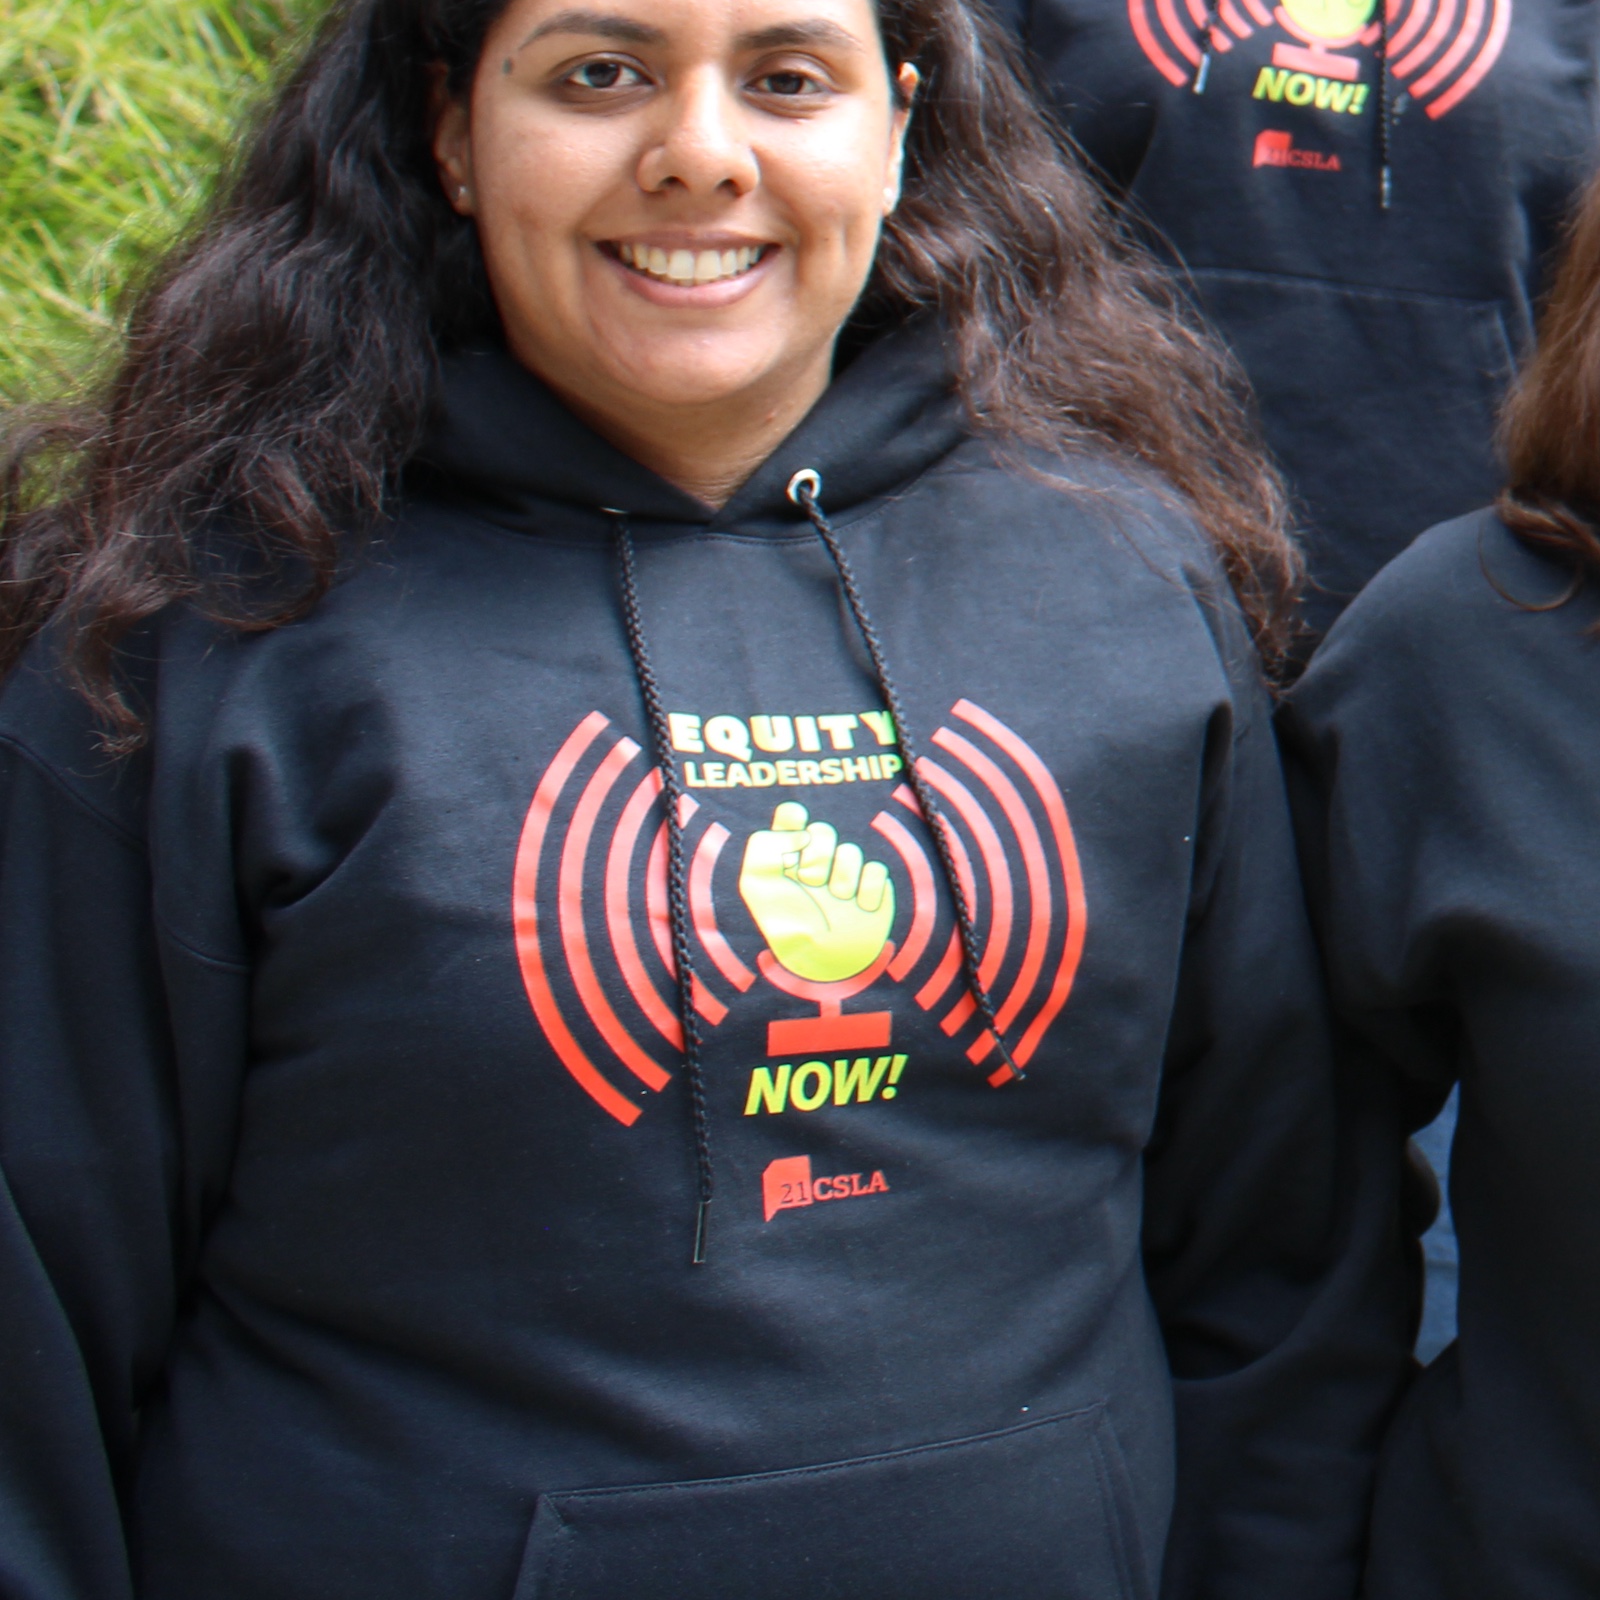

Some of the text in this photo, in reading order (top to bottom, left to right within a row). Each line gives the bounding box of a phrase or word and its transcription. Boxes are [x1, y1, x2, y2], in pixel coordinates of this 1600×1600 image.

[1252, 66, 1370, 115] NOW!
[668, 711, 897, 762] EQUITY
[684, 754, 904, 788] LEADERSHIP
[743, 1054, 909, 1116] NOW!
[780, 1170, 890, 1205] 21CSLA
